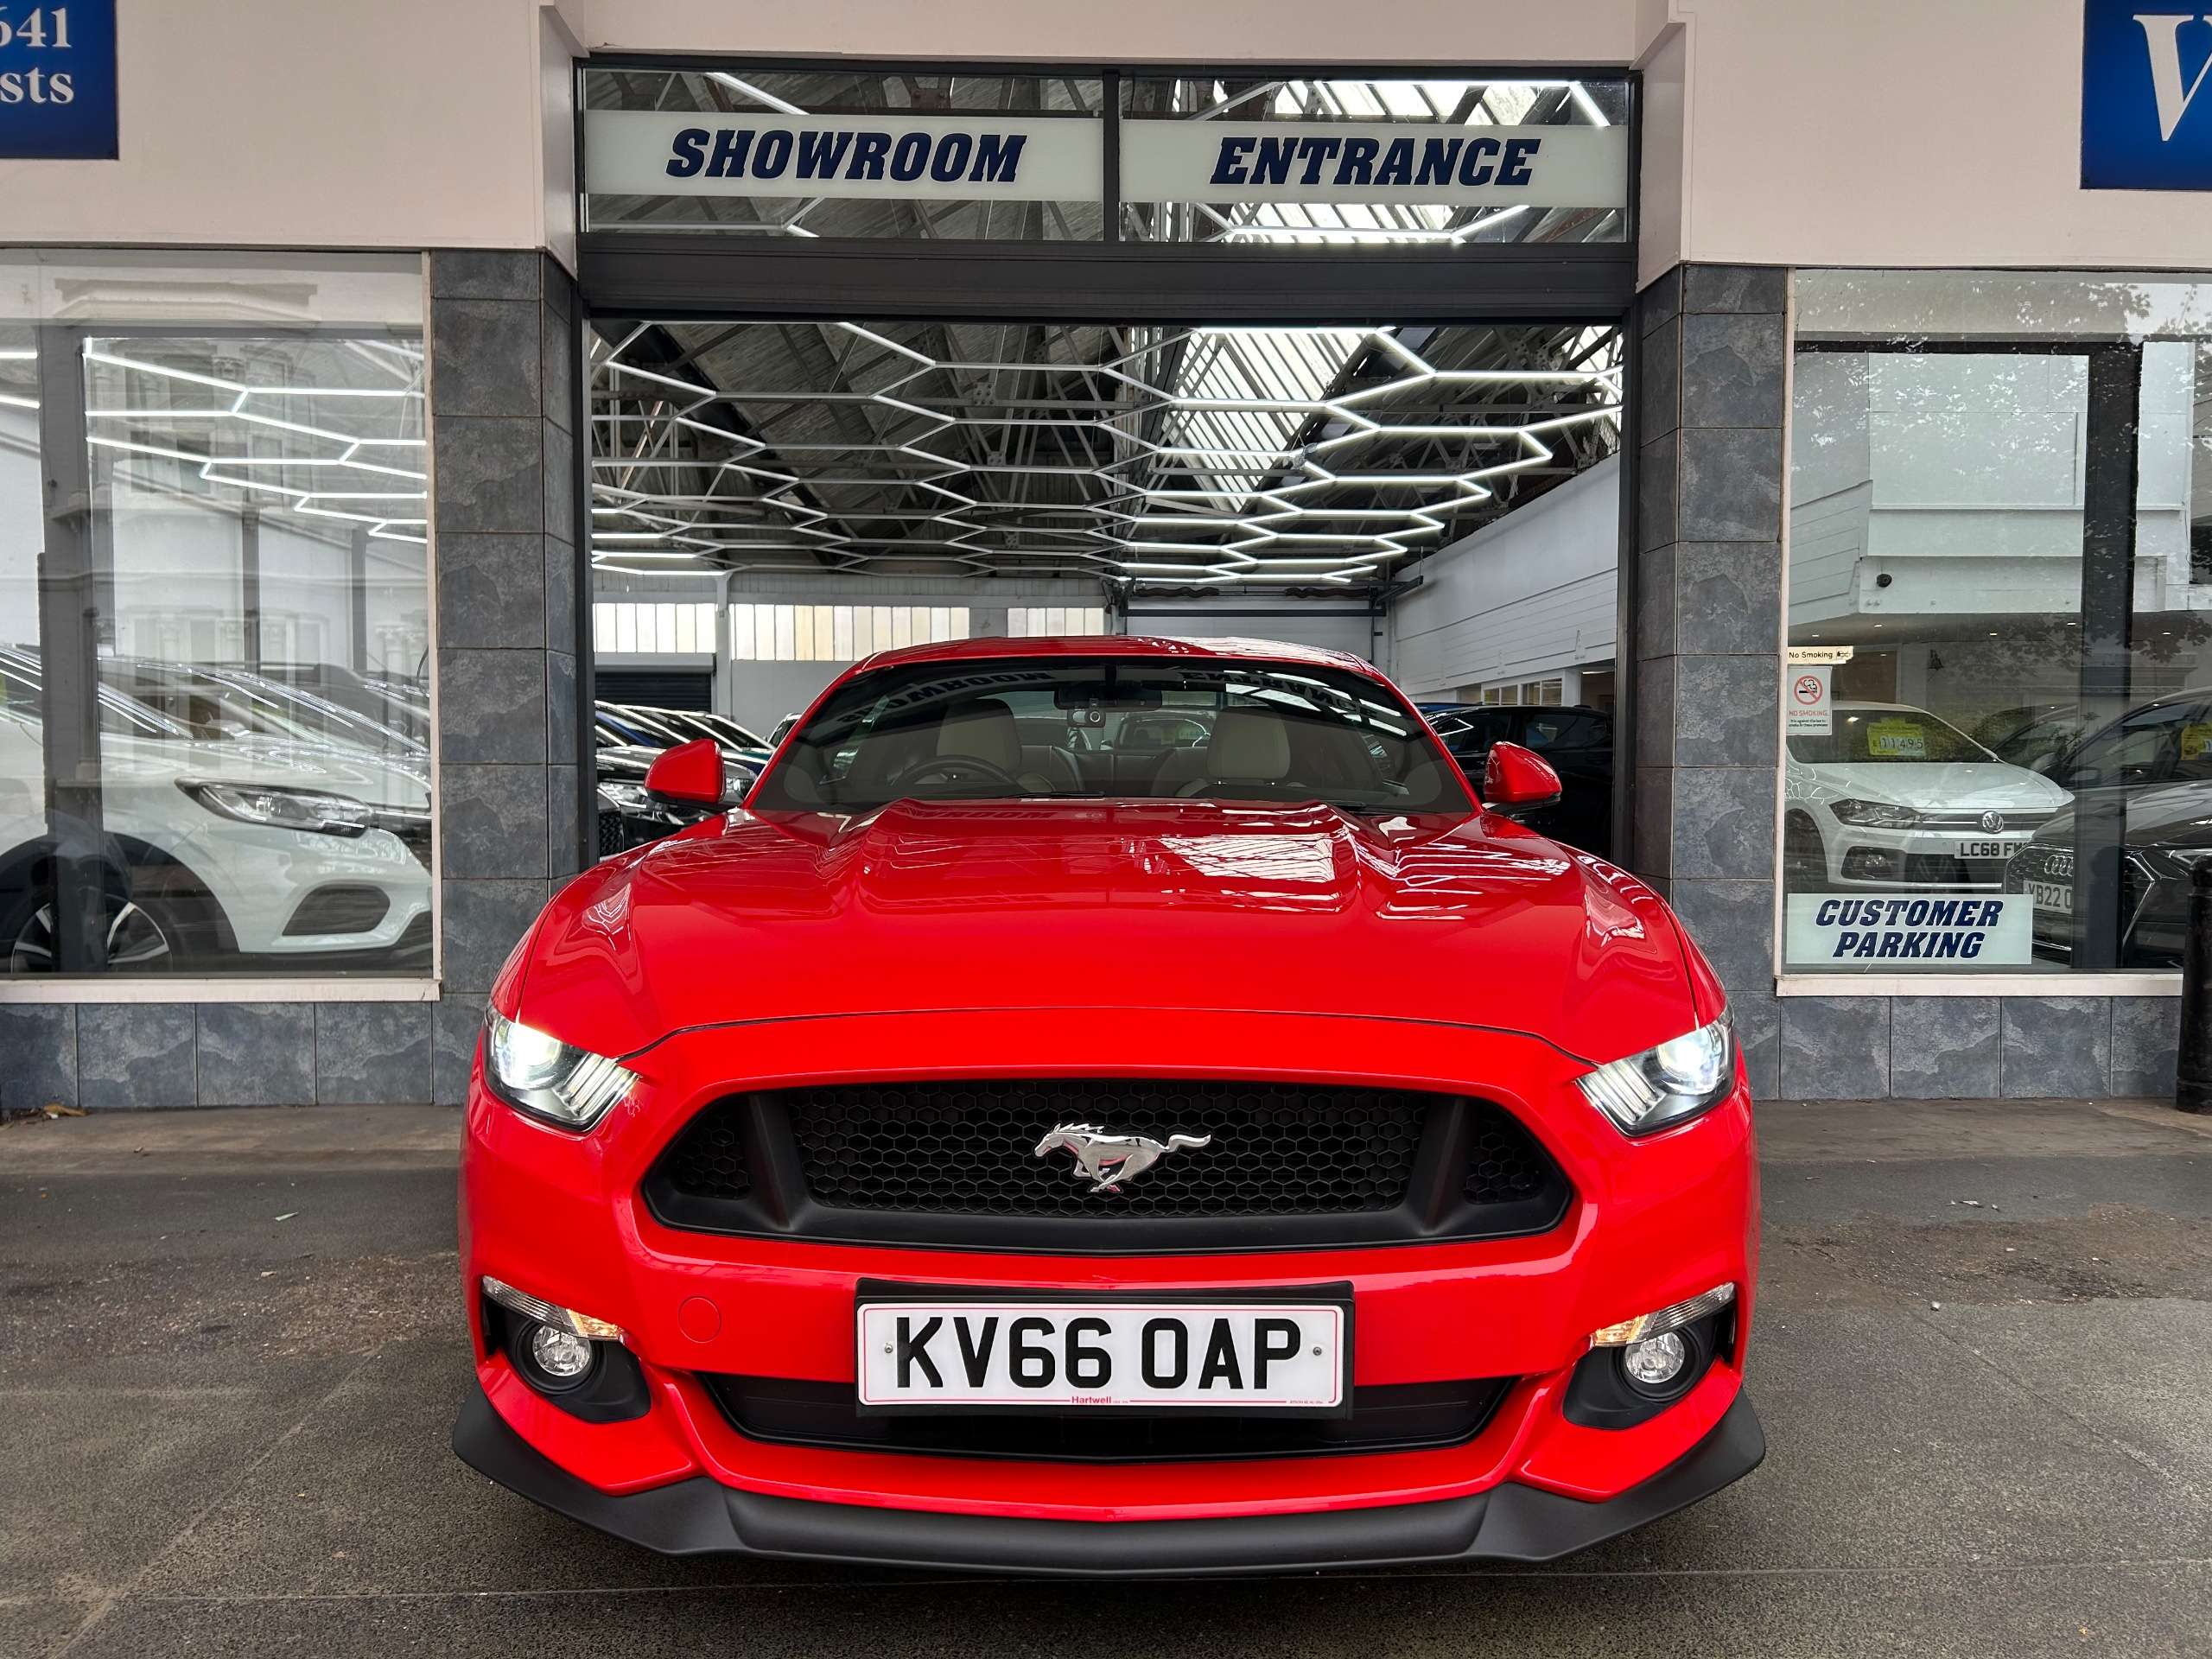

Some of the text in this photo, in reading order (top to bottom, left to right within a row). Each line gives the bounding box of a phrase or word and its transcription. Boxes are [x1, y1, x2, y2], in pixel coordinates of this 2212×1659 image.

[0, 67, 74, 104] sts
[665, 128, 1542, 187] SHOWROOM ENTRANCE
[1960, 842, 2000, 857] LC68
[1815, 899, 2004, 927] CUSTOMER
[1832, 931, 1986, 959] PARKING
[896, 1316, 1301, 1389] KV66 OAP
[1071, 1395, 1112, 1404] Hartwell
